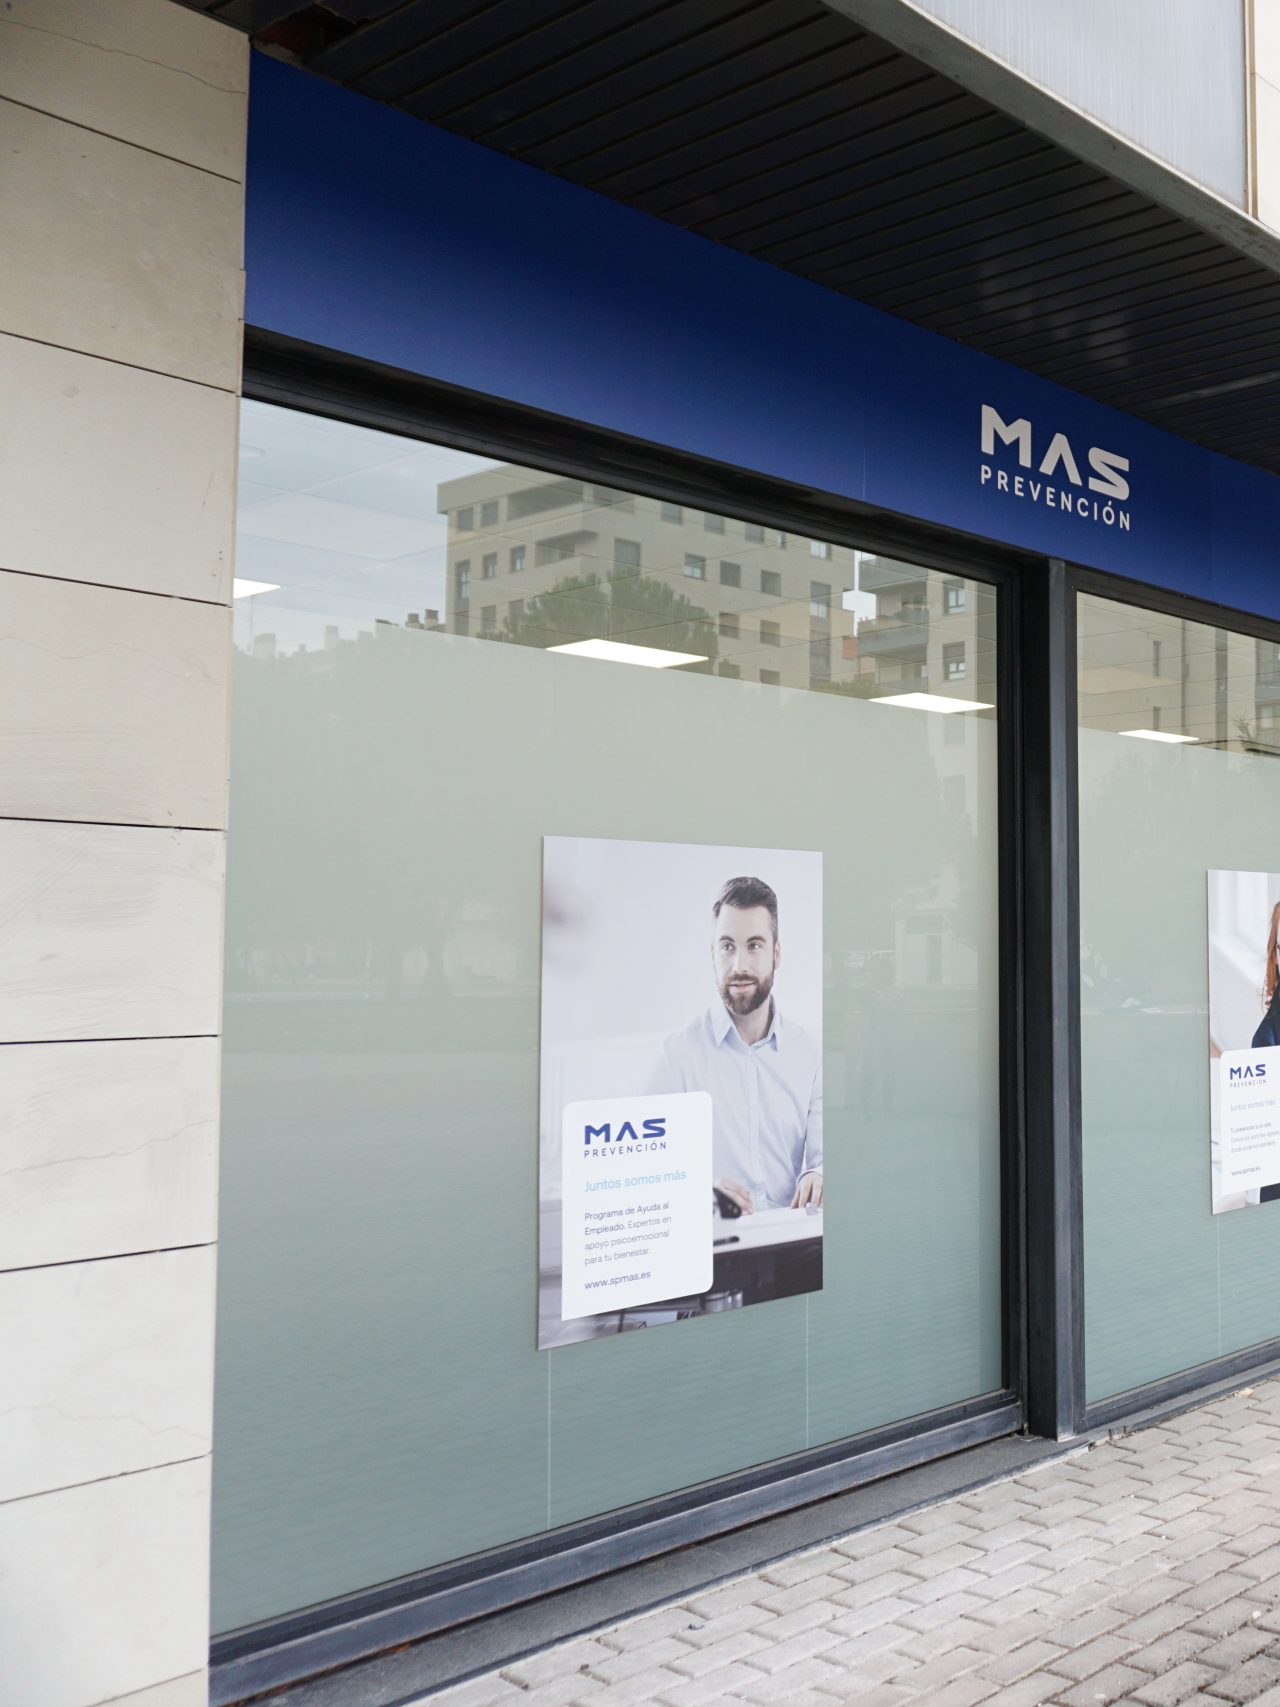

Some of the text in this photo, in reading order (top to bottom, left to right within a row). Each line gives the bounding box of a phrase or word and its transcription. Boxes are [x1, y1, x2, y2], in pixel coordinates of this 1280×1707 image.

[981, 404, 1131, 501] MAS
[980, 464, 1131, 531] PREVENCIÓN
[1230, 1064, 1266, 1080] MAS
[584, 1117, 666, 1145] MAS
[584, 1139, 667, 1158] PREVENCIÓN
[584, 1169, 687, 1193] Juntos somos más
[584, 1202, 670, 1221] Programa de Ayuda al
[584, 1223, 626, 1236] Empleado.
[627, 1218, 660, 1229] Expertos
[584, 1229, 670, 1251] apoyo psicoemocional
[584, 1256, 602, 1268] para
[604, 1254, 612, 1262] tu
[584, 1271, 651, 1290] www.spmas.es
